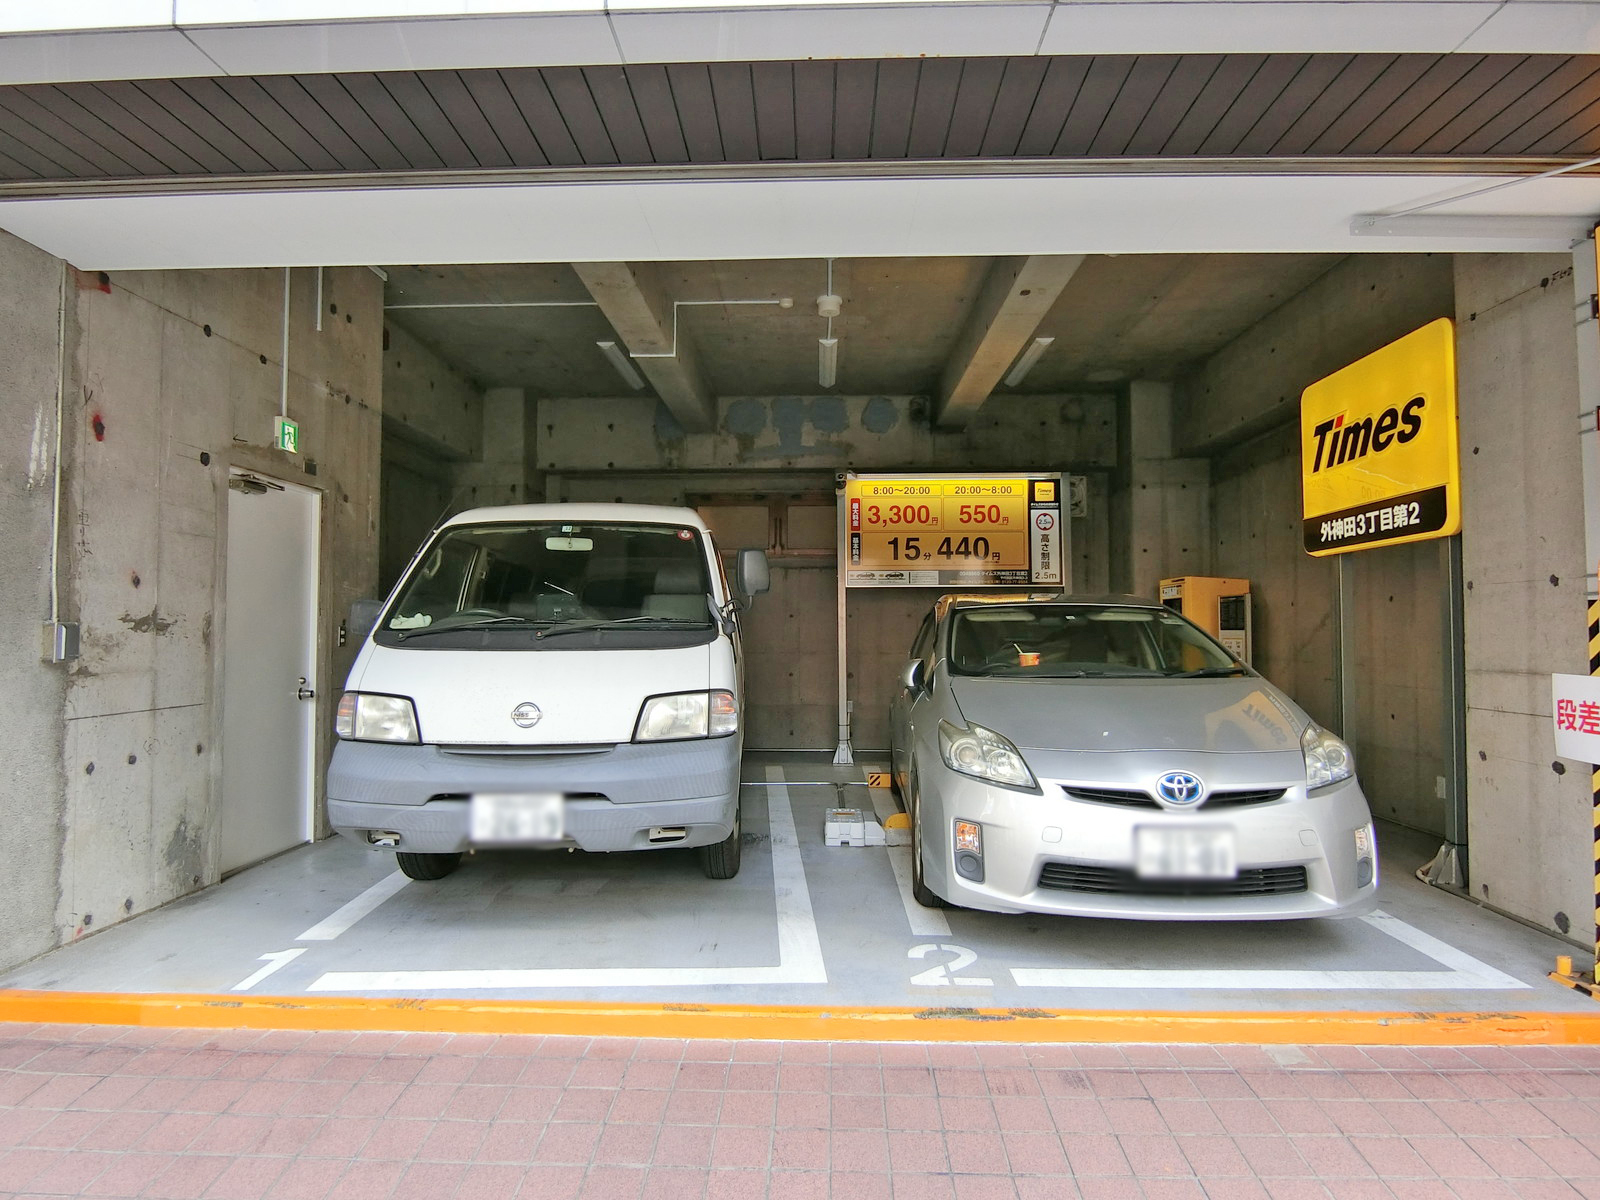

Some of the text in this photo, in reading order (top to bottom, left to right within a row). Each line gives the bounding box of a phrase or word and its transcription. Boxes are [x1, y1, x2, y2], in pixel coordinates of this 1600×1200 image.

[1312, 396, 1425, 474] Times
[1320, 502, 1420, 542] 外神田3丁目第2
[1040, 534, 1050, 570] 高さ制限
[1035, 572, 1057, 580] 2.5m
[1557, 698, 1600, 735] 段差
[230, 947, 308, 991] 1
[908, 943, 994, 986] 2
